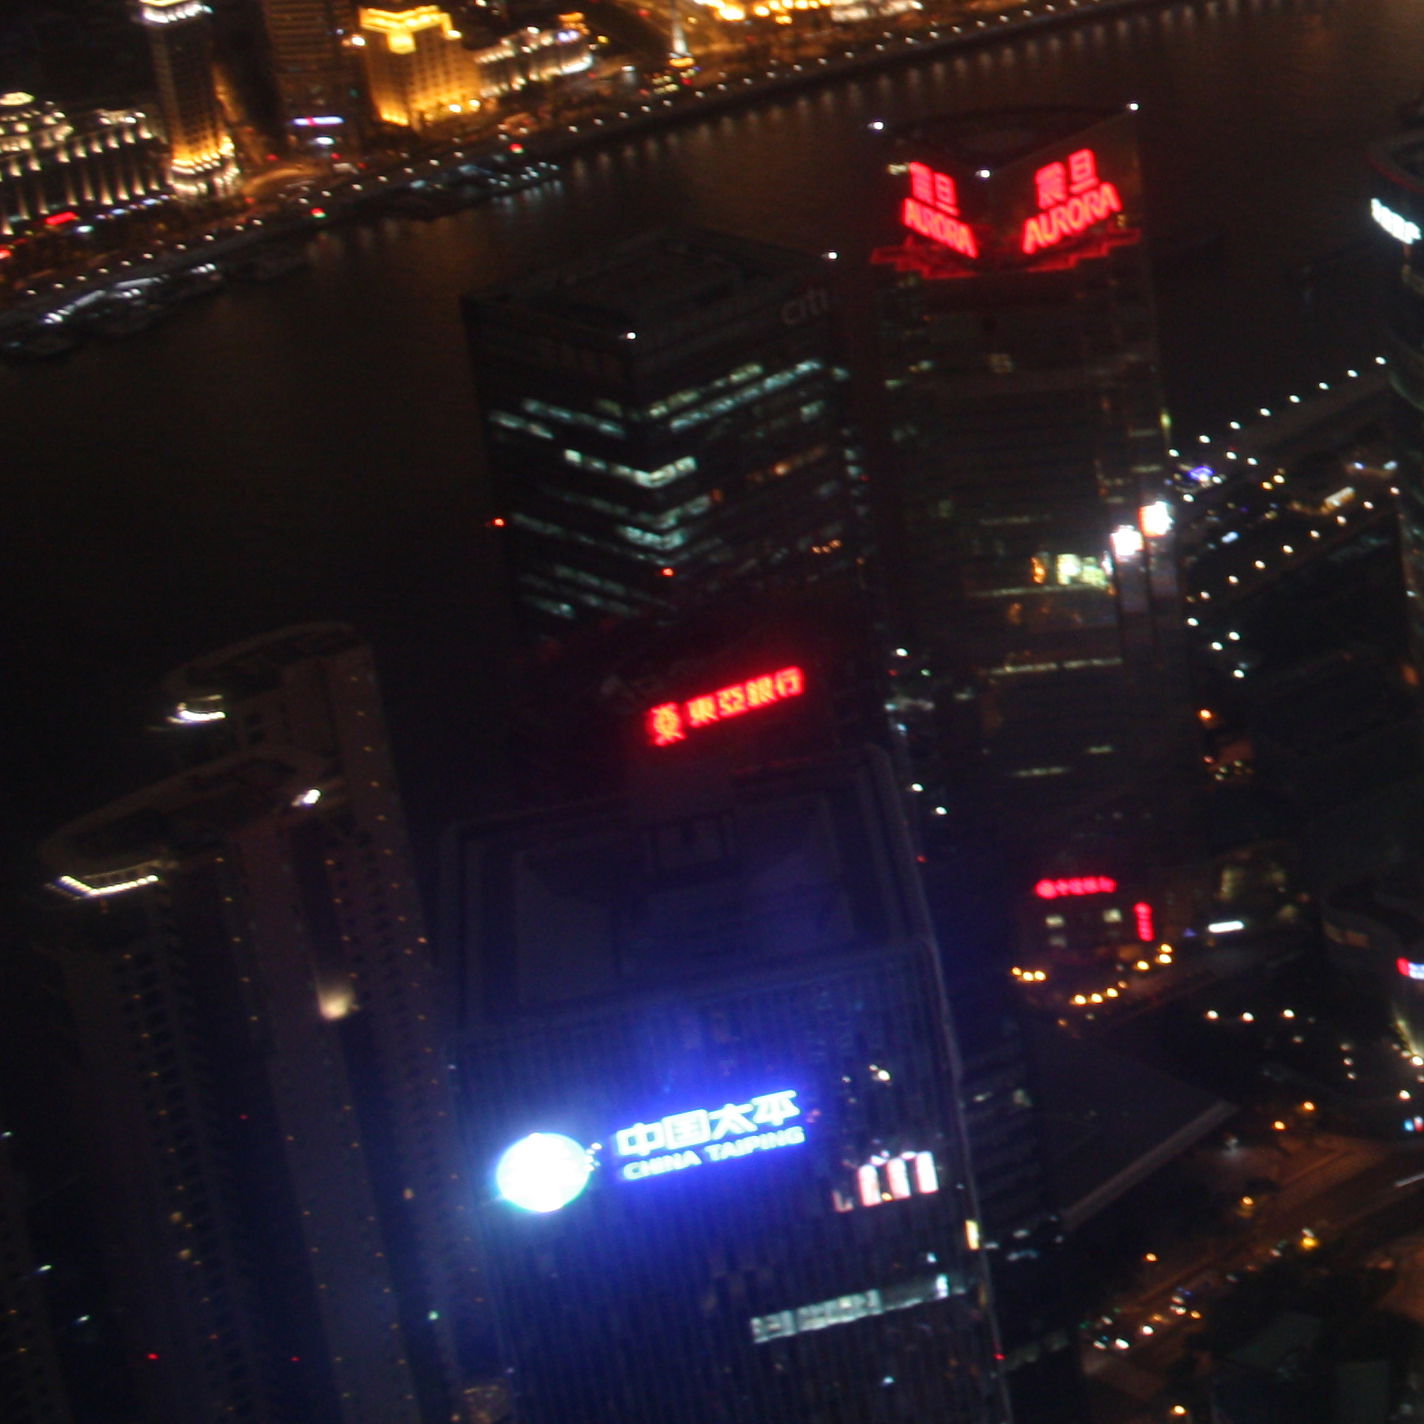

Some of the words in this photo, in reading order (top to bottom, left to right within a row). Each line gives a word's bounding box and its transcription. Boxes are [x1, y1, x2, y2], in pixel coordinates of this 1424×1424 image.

[1035, 148, 1099, 210] 震旦
[903, 197, 979, 259] AURORA
[1022, 182, 1122, 254] AURORA
[616, 1090, 801, 1156] 中国太平
[623, 1150, 703, 1180] CHINA
[704, 1126, 806, 1161] TAIPING
